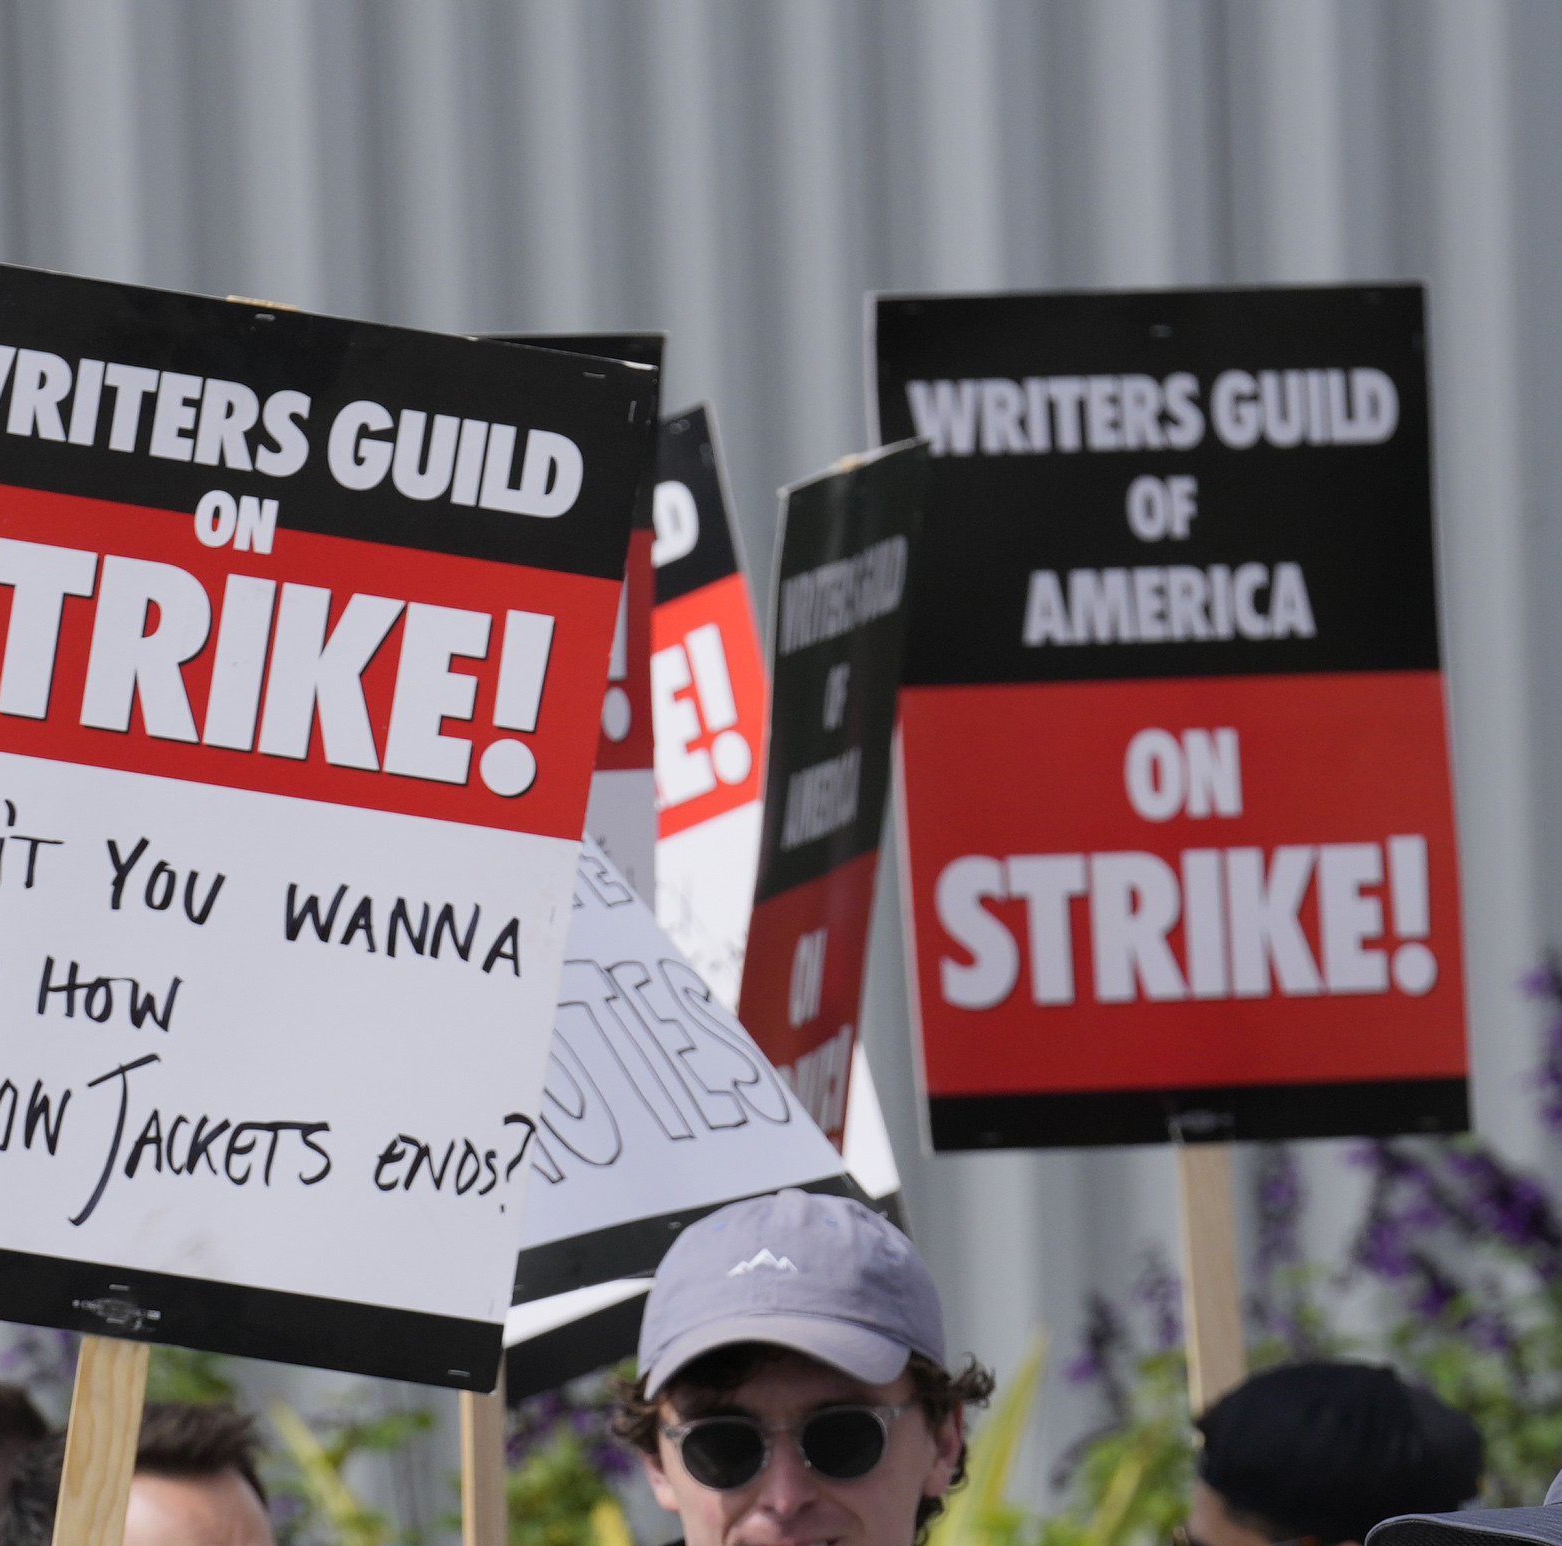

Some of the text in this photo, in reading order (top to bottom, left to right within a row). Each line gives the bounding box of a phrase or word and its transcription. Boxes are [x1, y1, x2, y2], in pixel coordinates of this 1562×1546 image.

[906, 366, 1399, 458] WRITERS GUILD
[326, 399, 586, 520] GUILD
[193, 489, 280, 556] ON
[1126, 474, 1198, 542] OF
[1022, 562, 1317, 648] AMERICA
[1124, 726, 1243, 822] ON
[106, 835, 227, 926] YOU
[284, 882, 524, 978] WANNA
[934, 833, 1439, 1012] STRIKE!
[36, 955, 185, 1033] HOW
[373, 1112, 537, 1215] ENDS?
